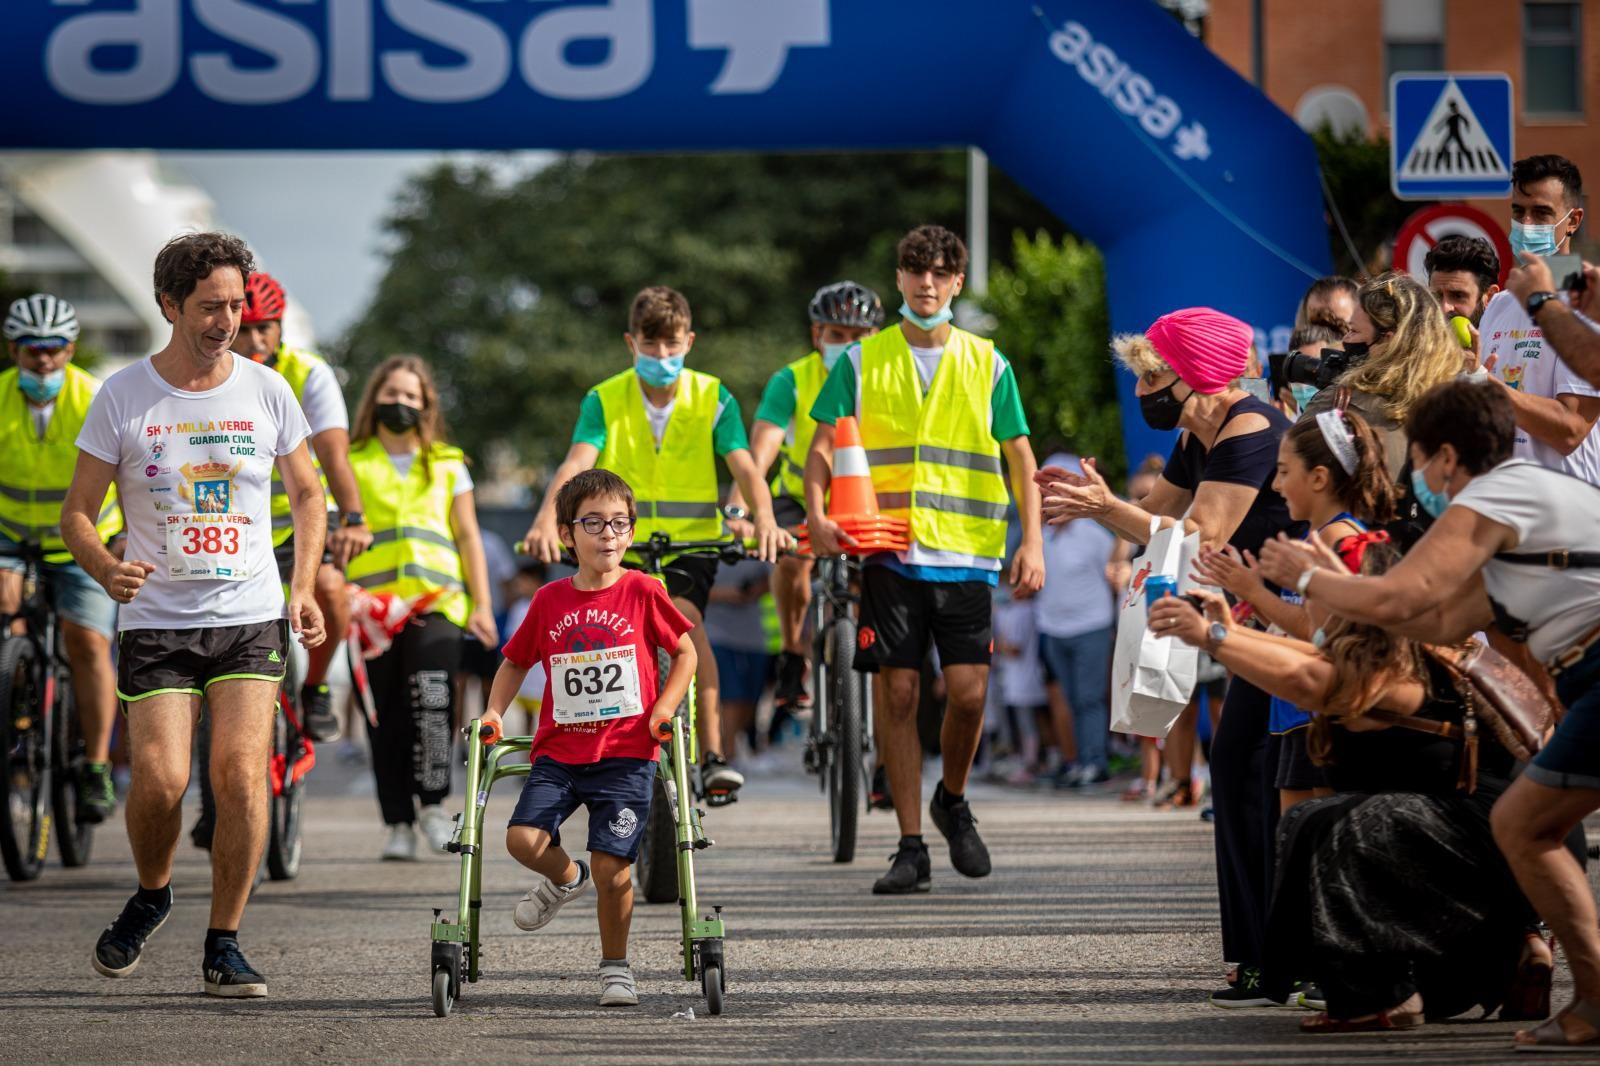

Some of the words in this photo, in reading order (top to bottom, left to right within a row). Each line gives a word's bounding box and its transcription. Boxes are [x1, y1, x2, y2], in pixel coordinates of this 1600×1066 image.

[45, 0, 654, 104] asisa
[1050, 20, 1182, 139] asisa
[147, 425, 161, 437] 5K
[165, 425, 173, 434] Y
[176, 421, 215, 434] MILLA
[218, 420, 254, 432] VERDE
[189, 435, 230, 445] GUARDIA
[232, 435, 255, 444] CIVIL
[230, 445, 256, 456] CÁDIZ
[167, 515, 179, 525] 5K
[192, 514, 224, 523] MILLA
[182, 526, 239, 555] 383
[549, 609, 580, 643] AHOY
[586, 608, 635, 637] MATEY
[552, 656, 562, 665] 5K
[571, 653, 602, 664] MILLA
[605, 648, 634, 660] VERDE
[417, 670, 450, 709] LOS
[564, 663, 625, 697] 632
